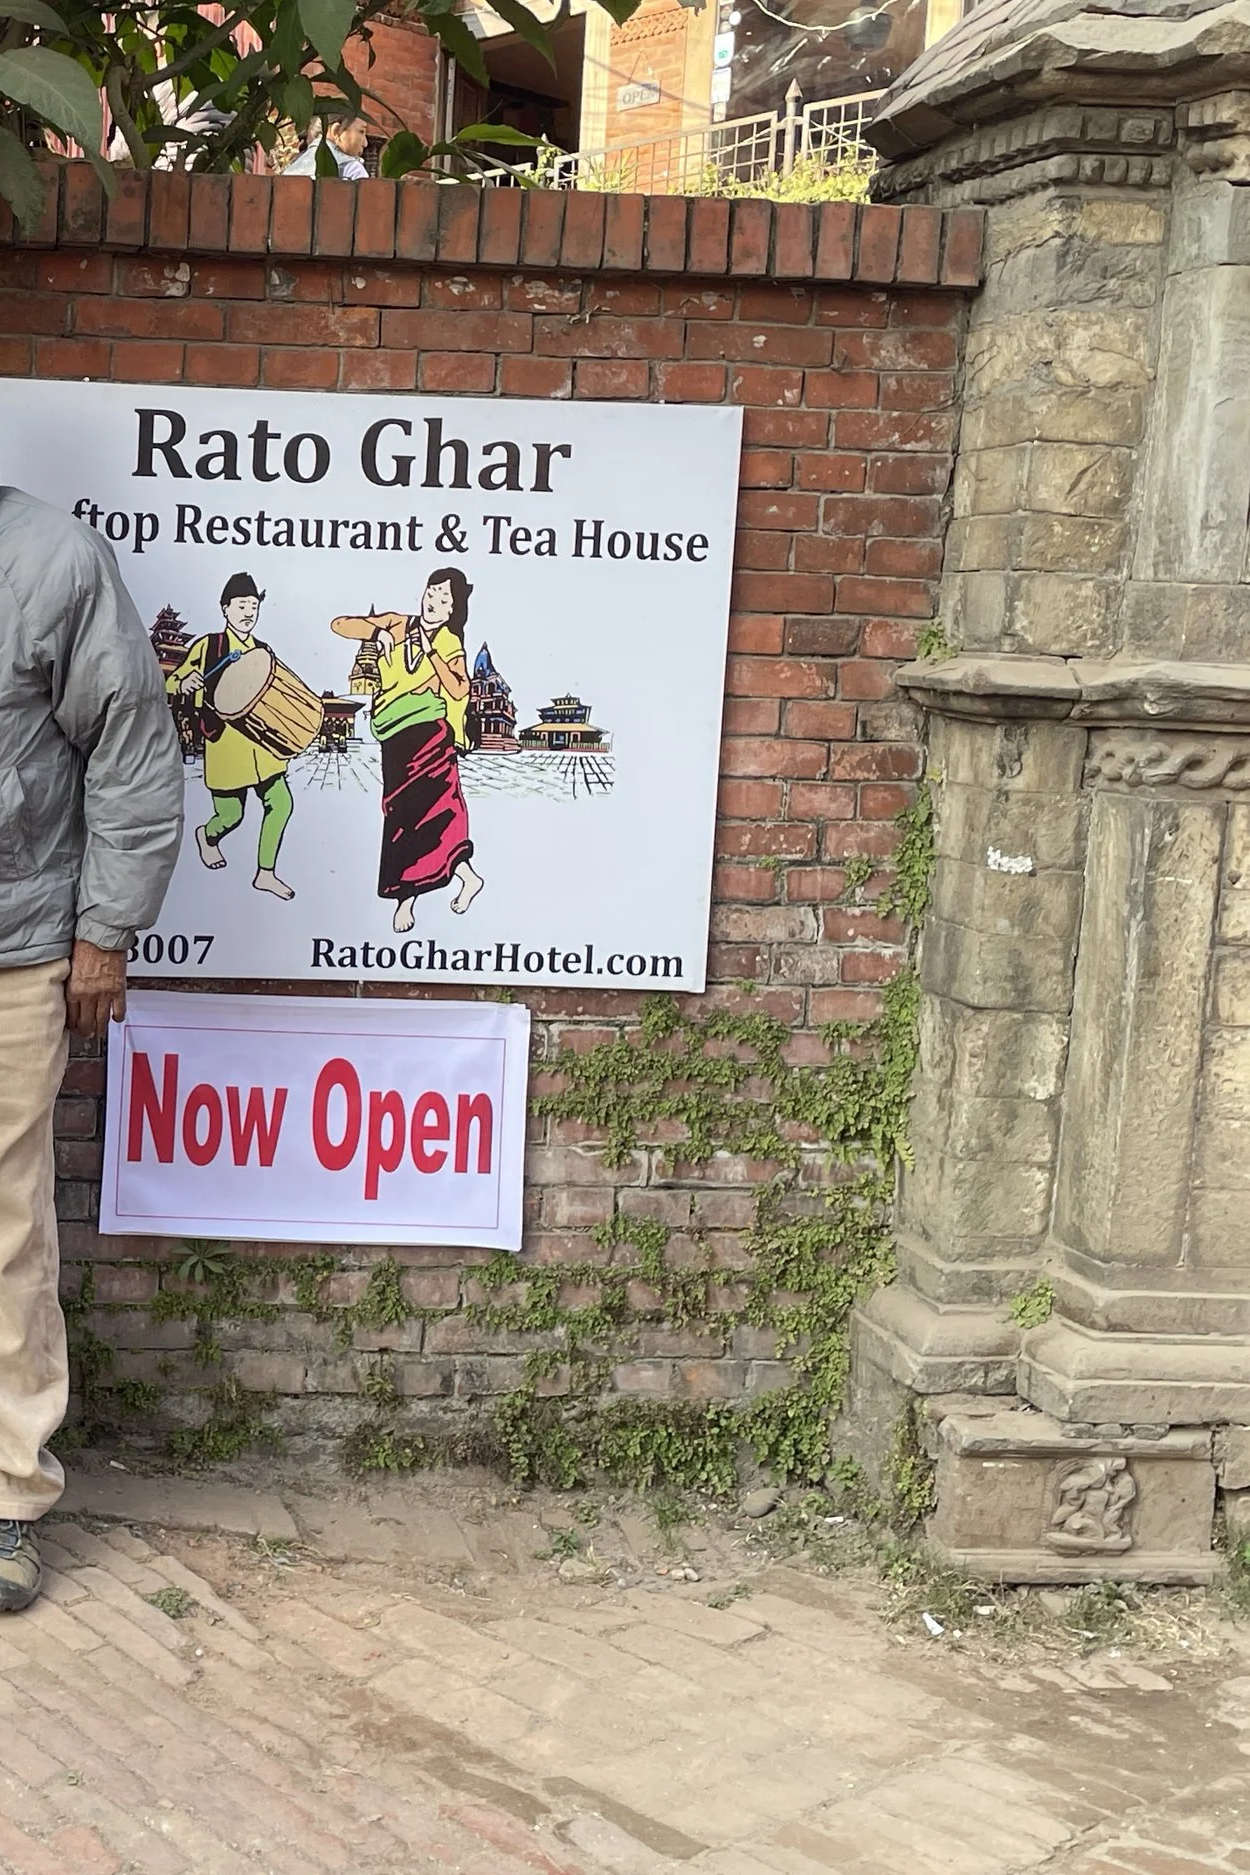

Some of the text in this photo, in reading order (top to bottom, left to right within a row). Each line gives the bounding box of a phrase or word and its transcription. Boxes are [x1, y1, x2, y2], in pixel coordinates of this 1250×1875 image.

[131, 408, 572, 493] Rato Ghar
[71, 498, 710, 563] ftop Restaurant & Tea House
[310, 938, 684, 979] RatoGharHotel.com
[127, 1051, 493, 1200] Now Open
